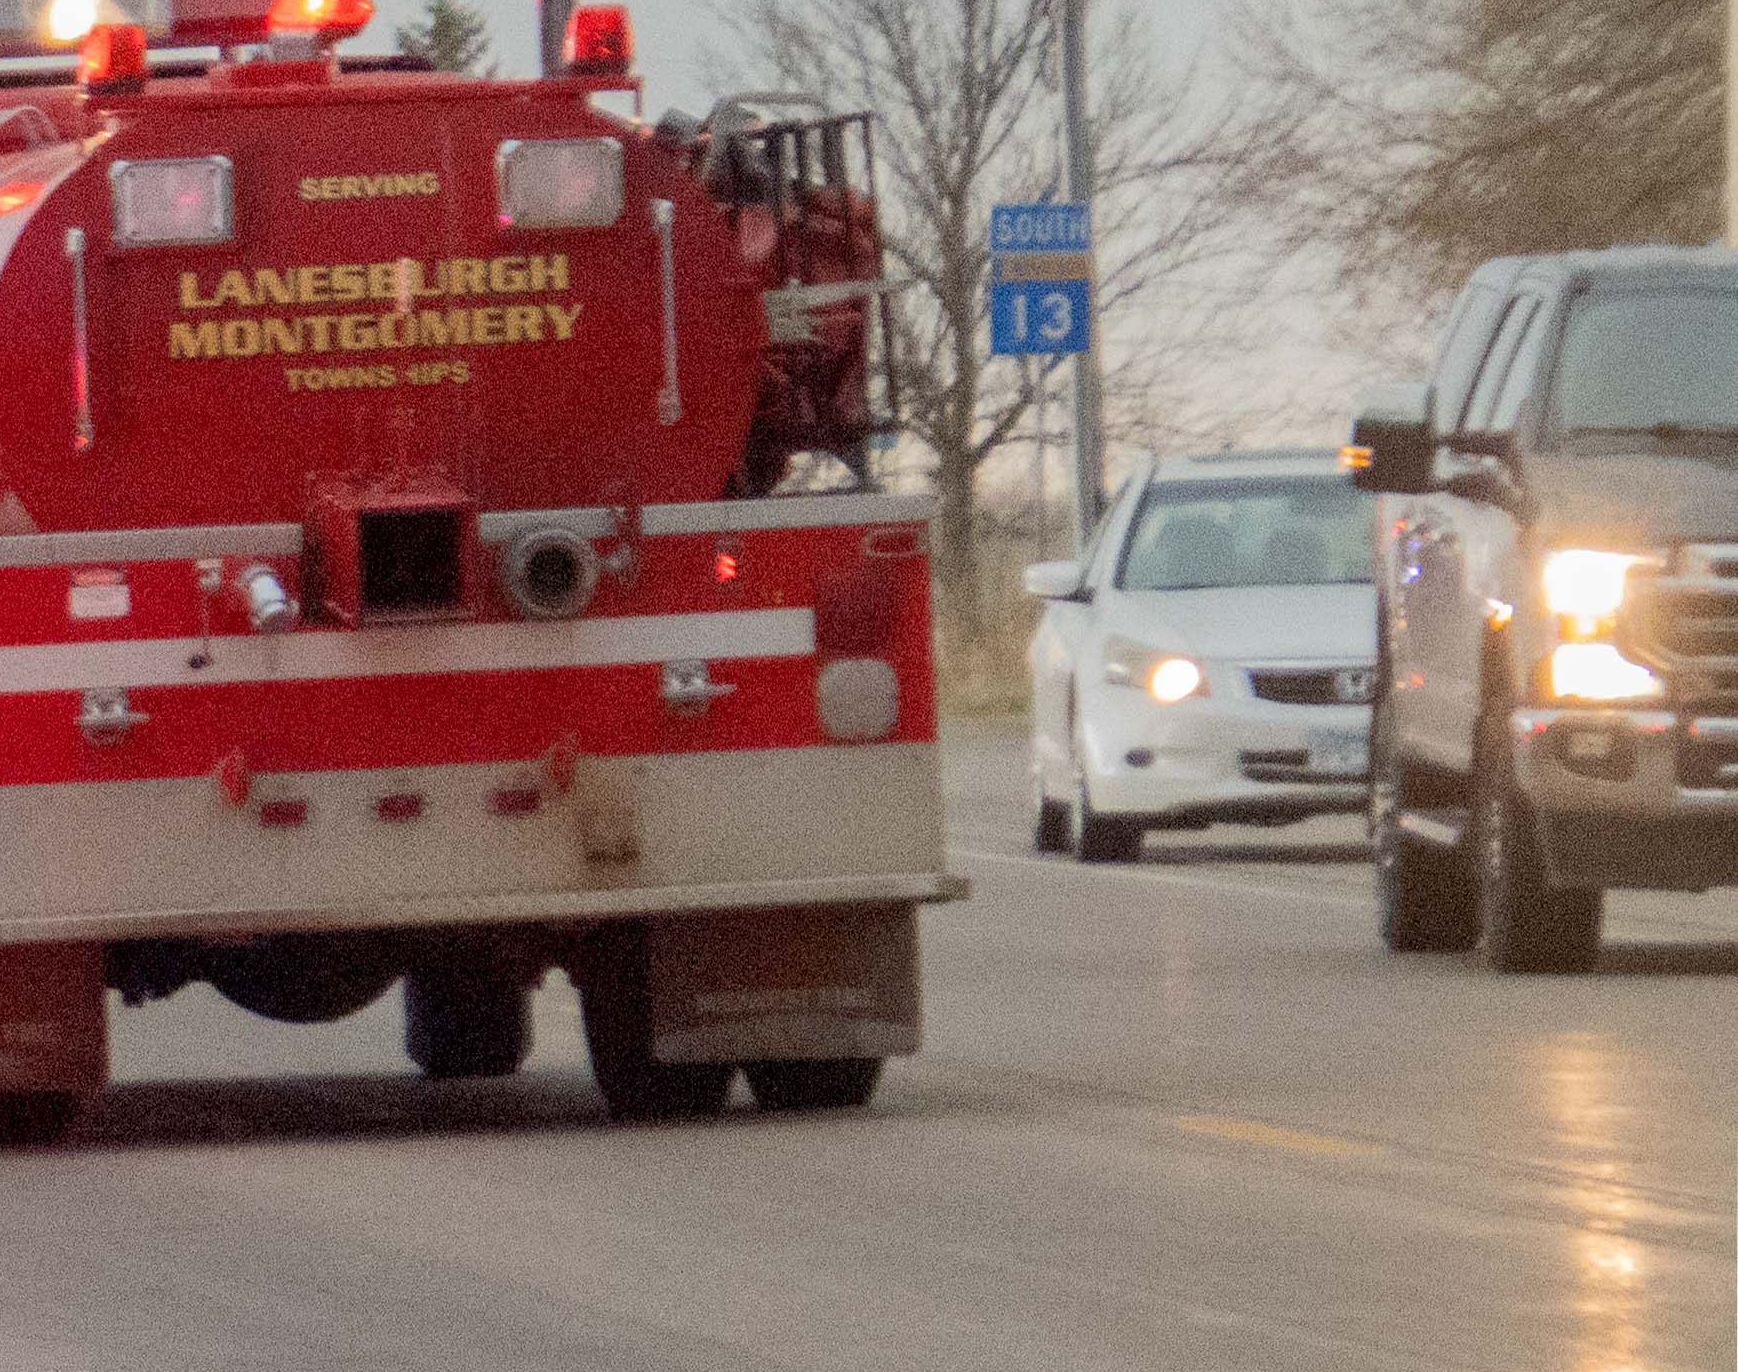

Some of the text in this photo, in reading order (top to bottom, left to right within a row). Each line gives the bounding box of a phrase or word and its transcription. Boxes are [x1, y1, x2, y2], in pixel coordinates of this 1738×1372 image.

[298, 172, 440, 201] SERVING
[997, 211, 1089, 244] SOUTH
[178, 253, 570, 308] LANESBURGH
[168, 303, 585, 359] MONTGOMERY
[1013, 292, 1072, 342] 13
